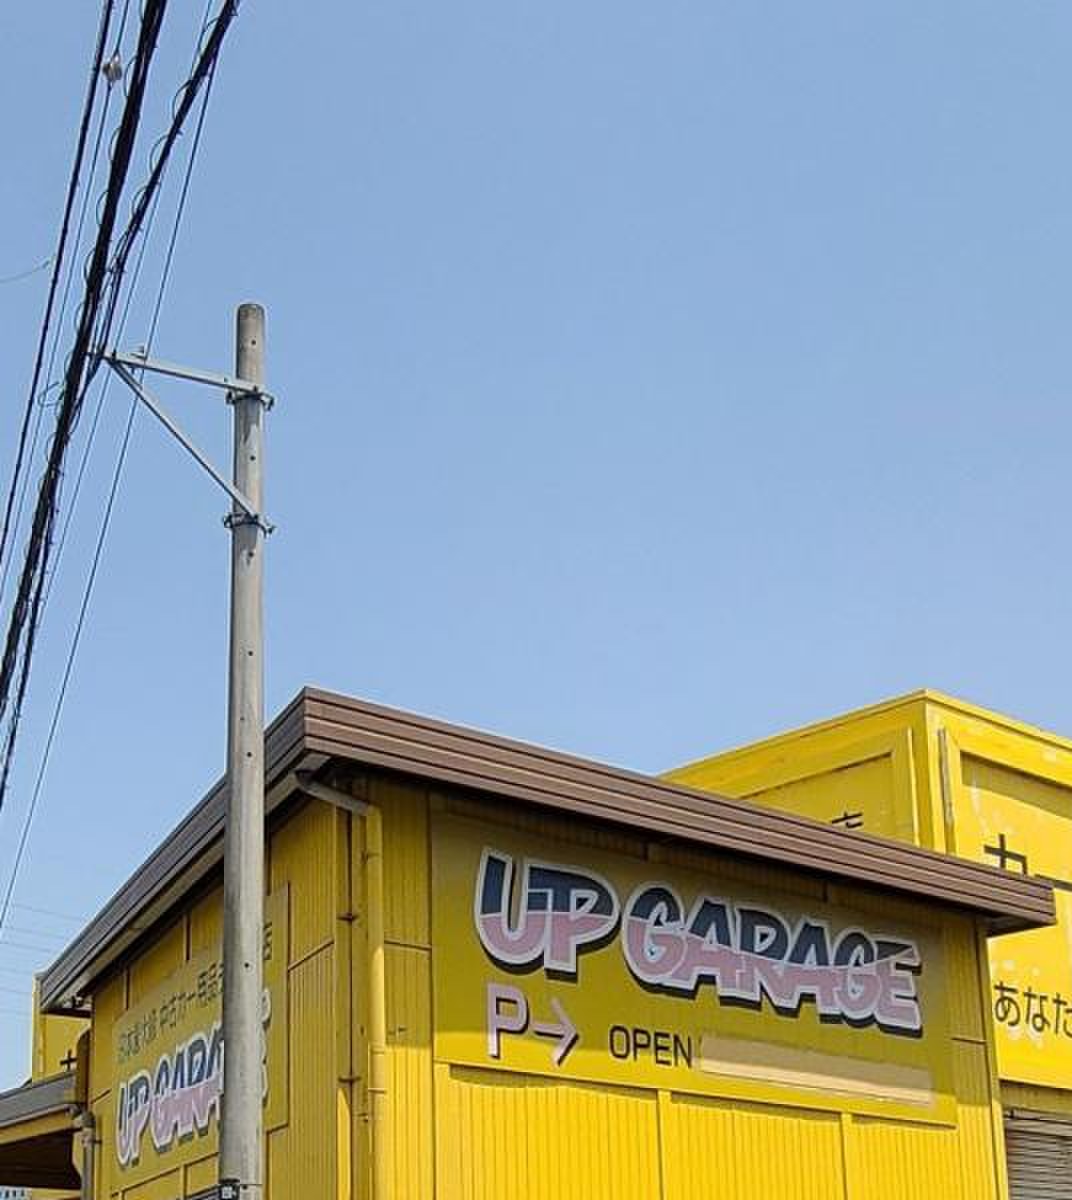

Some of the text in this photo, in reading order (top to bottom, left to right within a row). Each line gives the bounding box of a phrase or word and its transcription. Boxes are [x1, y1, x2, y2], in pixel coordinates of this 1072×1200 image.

[473, 847, 923, 1038] UP GARAGE
[485, 979, 530, 1060] P
[608, 1025, 693, 1068] OPEN
[116, 1069, 152, 1169] UP
